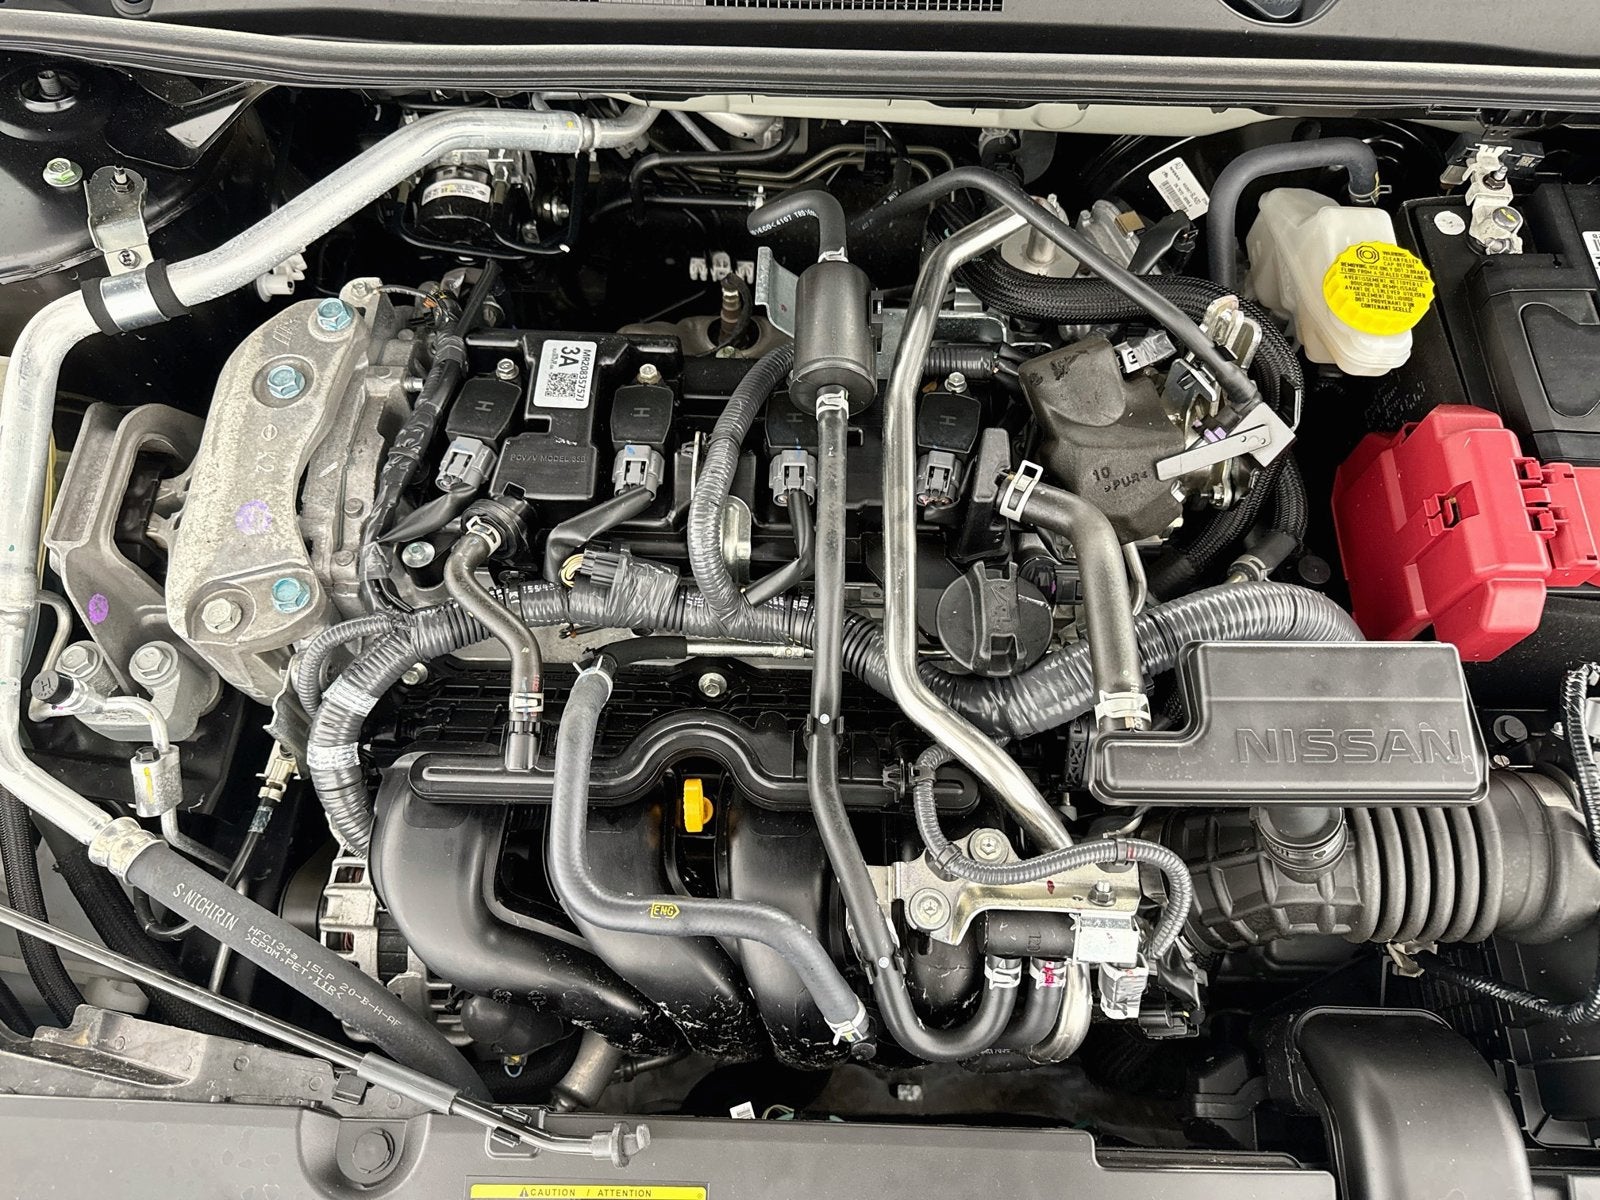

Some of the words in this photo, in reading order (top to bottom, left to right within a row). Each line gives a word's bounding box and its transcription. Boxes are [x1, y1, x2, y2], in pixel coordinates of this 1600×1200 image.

[559, 346, 581, 367] 3A
[540, 455, 569, 463] MODEL
[1092, 466, 1110, 481] 10
[1236, 728, 1463, 764] NISSAN
[653, 905, 675, 916] ENG
[248, 925, 299, 961] HFC134a
[305, 960, 335, 982] 15LP
[530, 1188, 576, 1197] CAUTION
[597, 1188, 652, 1198] ATTENTION
